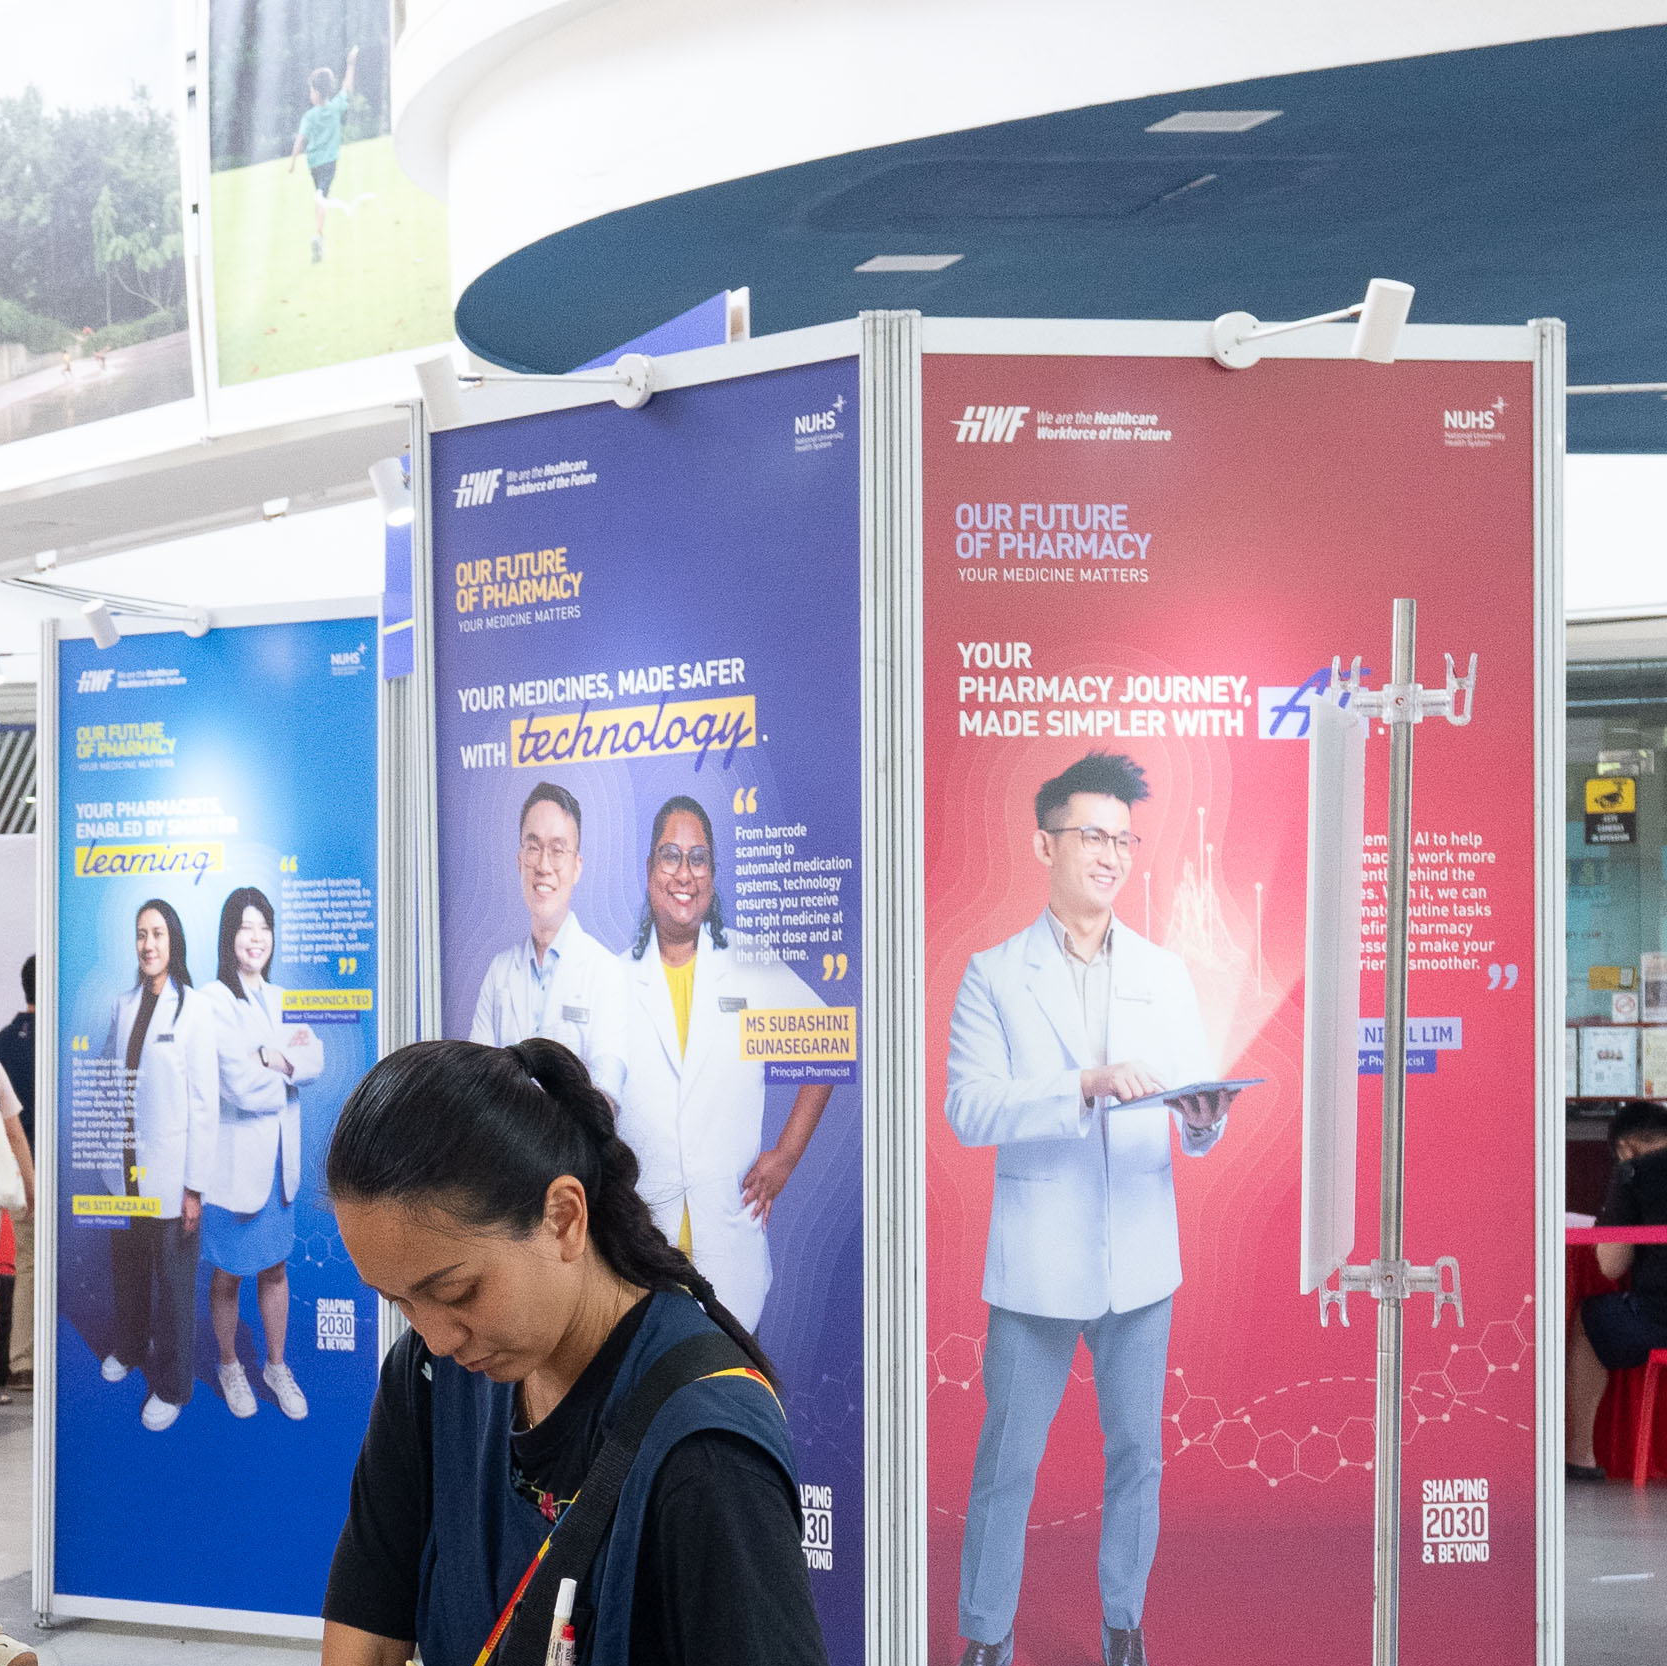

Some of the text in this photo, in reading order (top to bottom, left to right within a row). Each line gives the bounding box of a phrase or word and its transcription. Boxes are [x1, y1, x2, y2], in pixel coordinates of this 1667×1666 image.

[795, 410, 836, 435] NUHS
[1037, 411, 1158, 426] We are the Healthcare
[1445, 410, 1495, 430] NUHS
[1037, 426, 1172, 441] Workforce of the Future
[531, 466, 544, 479] the
[544, 460, 588, 476] Healthcare
[507, 480, 546, 497] Workforce
[556, 476, 569, 489] the
[571, 472, 597, 487] Future
[956, 503, 1129, 531] OUR FUTURE
[956, 532, 1152, 560] OF PHARMACY
[456, 547, 567, 587] OUR FUTURE
[958, 568, 1149, 583] YOUR MEDICINE MATTERS
[456, 571, 584, 613] OF PHARMACY
[458, 604, 582, 633] YOUR MEDICINE MATTERS
[331, 652, 361, 666] NUHS
[958, 641, 1032, 669] YOUR
[457, 657, 746, 713] YOUR MEDICINES, MADE SAFER
[959, 675, 1252, 708] PHARMACY JOURNEY,
[76, 721, 164, 742] OUR FUTURE
[959, 710, 1041, 738] MADE
[1046, 709, 1165, 738] SIMPLER
[1170, 709, 1244, 737] WITH
[76, 738, 177, 758] OF PHARMACY
[460, 742, 506, 769] WITH
[75, 802, 114, 820] YOUR
[76, 820, 143, 840] ENABLED
[145, 819, 165, 837] BY
[736, 822, 807, 841] From barcode
[1414, 831, 1483, 849] AI to help
[736, 842, 795, 859] scanning to
[1418, 849, 1496, 864] work more
[736, 856, 852, 876] automated medication
[1410, 867, 1475, 881] ehind the
[736, 874, 842, 896] systems, technology
[1419, 885, 1487, 900] it, we can
[736, 893, 839, 912] ensures you receive
[1408, 902, 1491, 917] outine tasks
[736, 910, 843, 930] the right medicine at
[1408, 921, 1473, 937] harmacy
[737, 928, 842, 947] the right dose and at
[755, 948, 780, 965] right
[782, 948, 809, 962] time.
[1420, 939, 1495, 957] make your
[1408, 955, 1481, 970] smoother.
[747, 1014, 849, 1033] MS SUBASHINI
[1422, 1026, 1453, 1042] LIM
[747, 1037, 850, 1055] GUNASEGARAN
[770, 1065, 850, 1079] Principal Pharmacist
[115, 1201, 138, 1212] AZZA
[317, 1298, 355, 1314] SHAPING
[320, 1315, 353, 1335] 2030
[317, 1337, 355, 1351] & BEYOND
[800, 1484, 832, 1509] PING
[1422, 1478, 1489, 1502] SHAPING
[802, 1513, 829, 1545] 30
[1426, 1506, 1485, 1539] 2030
[1422, 1543, 1489, 1564] & BEYOND
